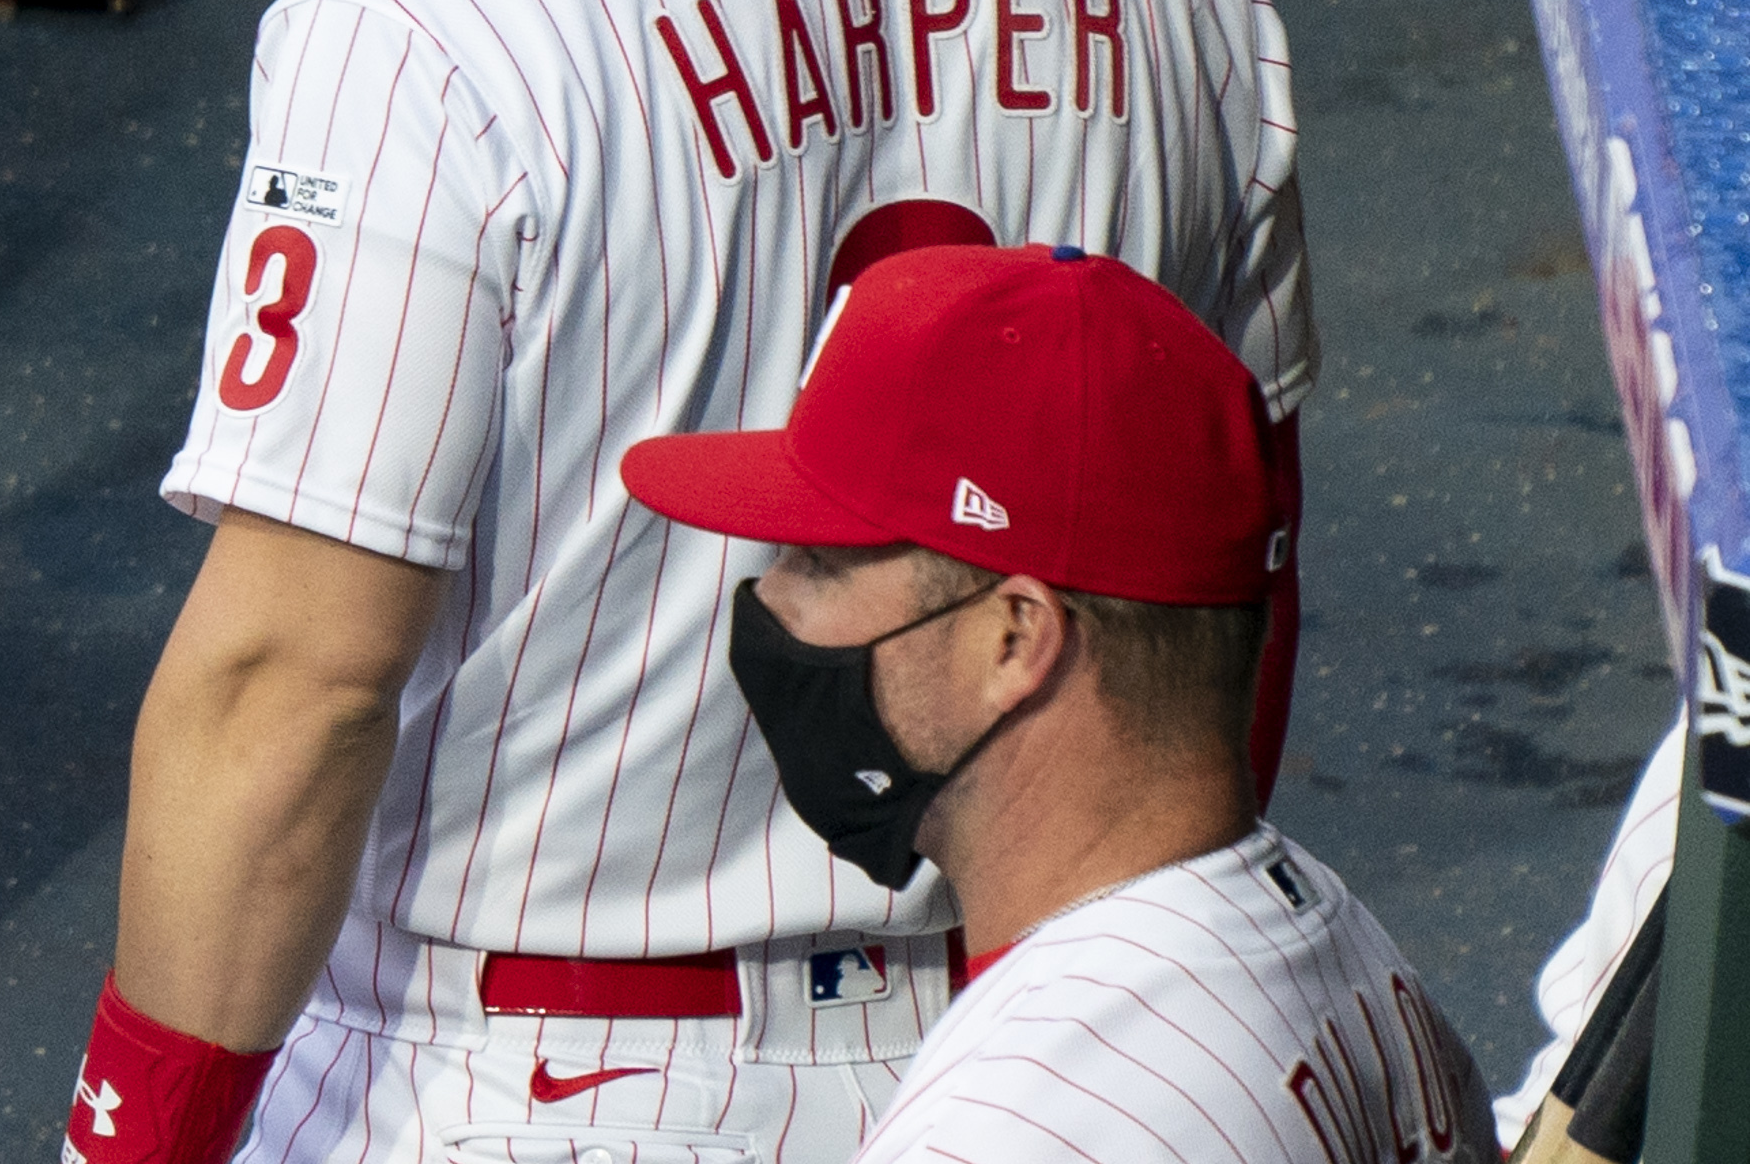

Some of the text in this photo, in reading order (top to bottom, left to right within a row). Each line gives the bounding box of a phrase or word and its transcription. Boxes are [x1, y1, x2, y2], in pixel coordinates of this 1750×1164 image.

[299, 175, 338, 193] UNITED
[297, 187, 317, 202] FOR
[293, 200, 337, 220] CHANGE
[218, 224, 318, 411] 3
